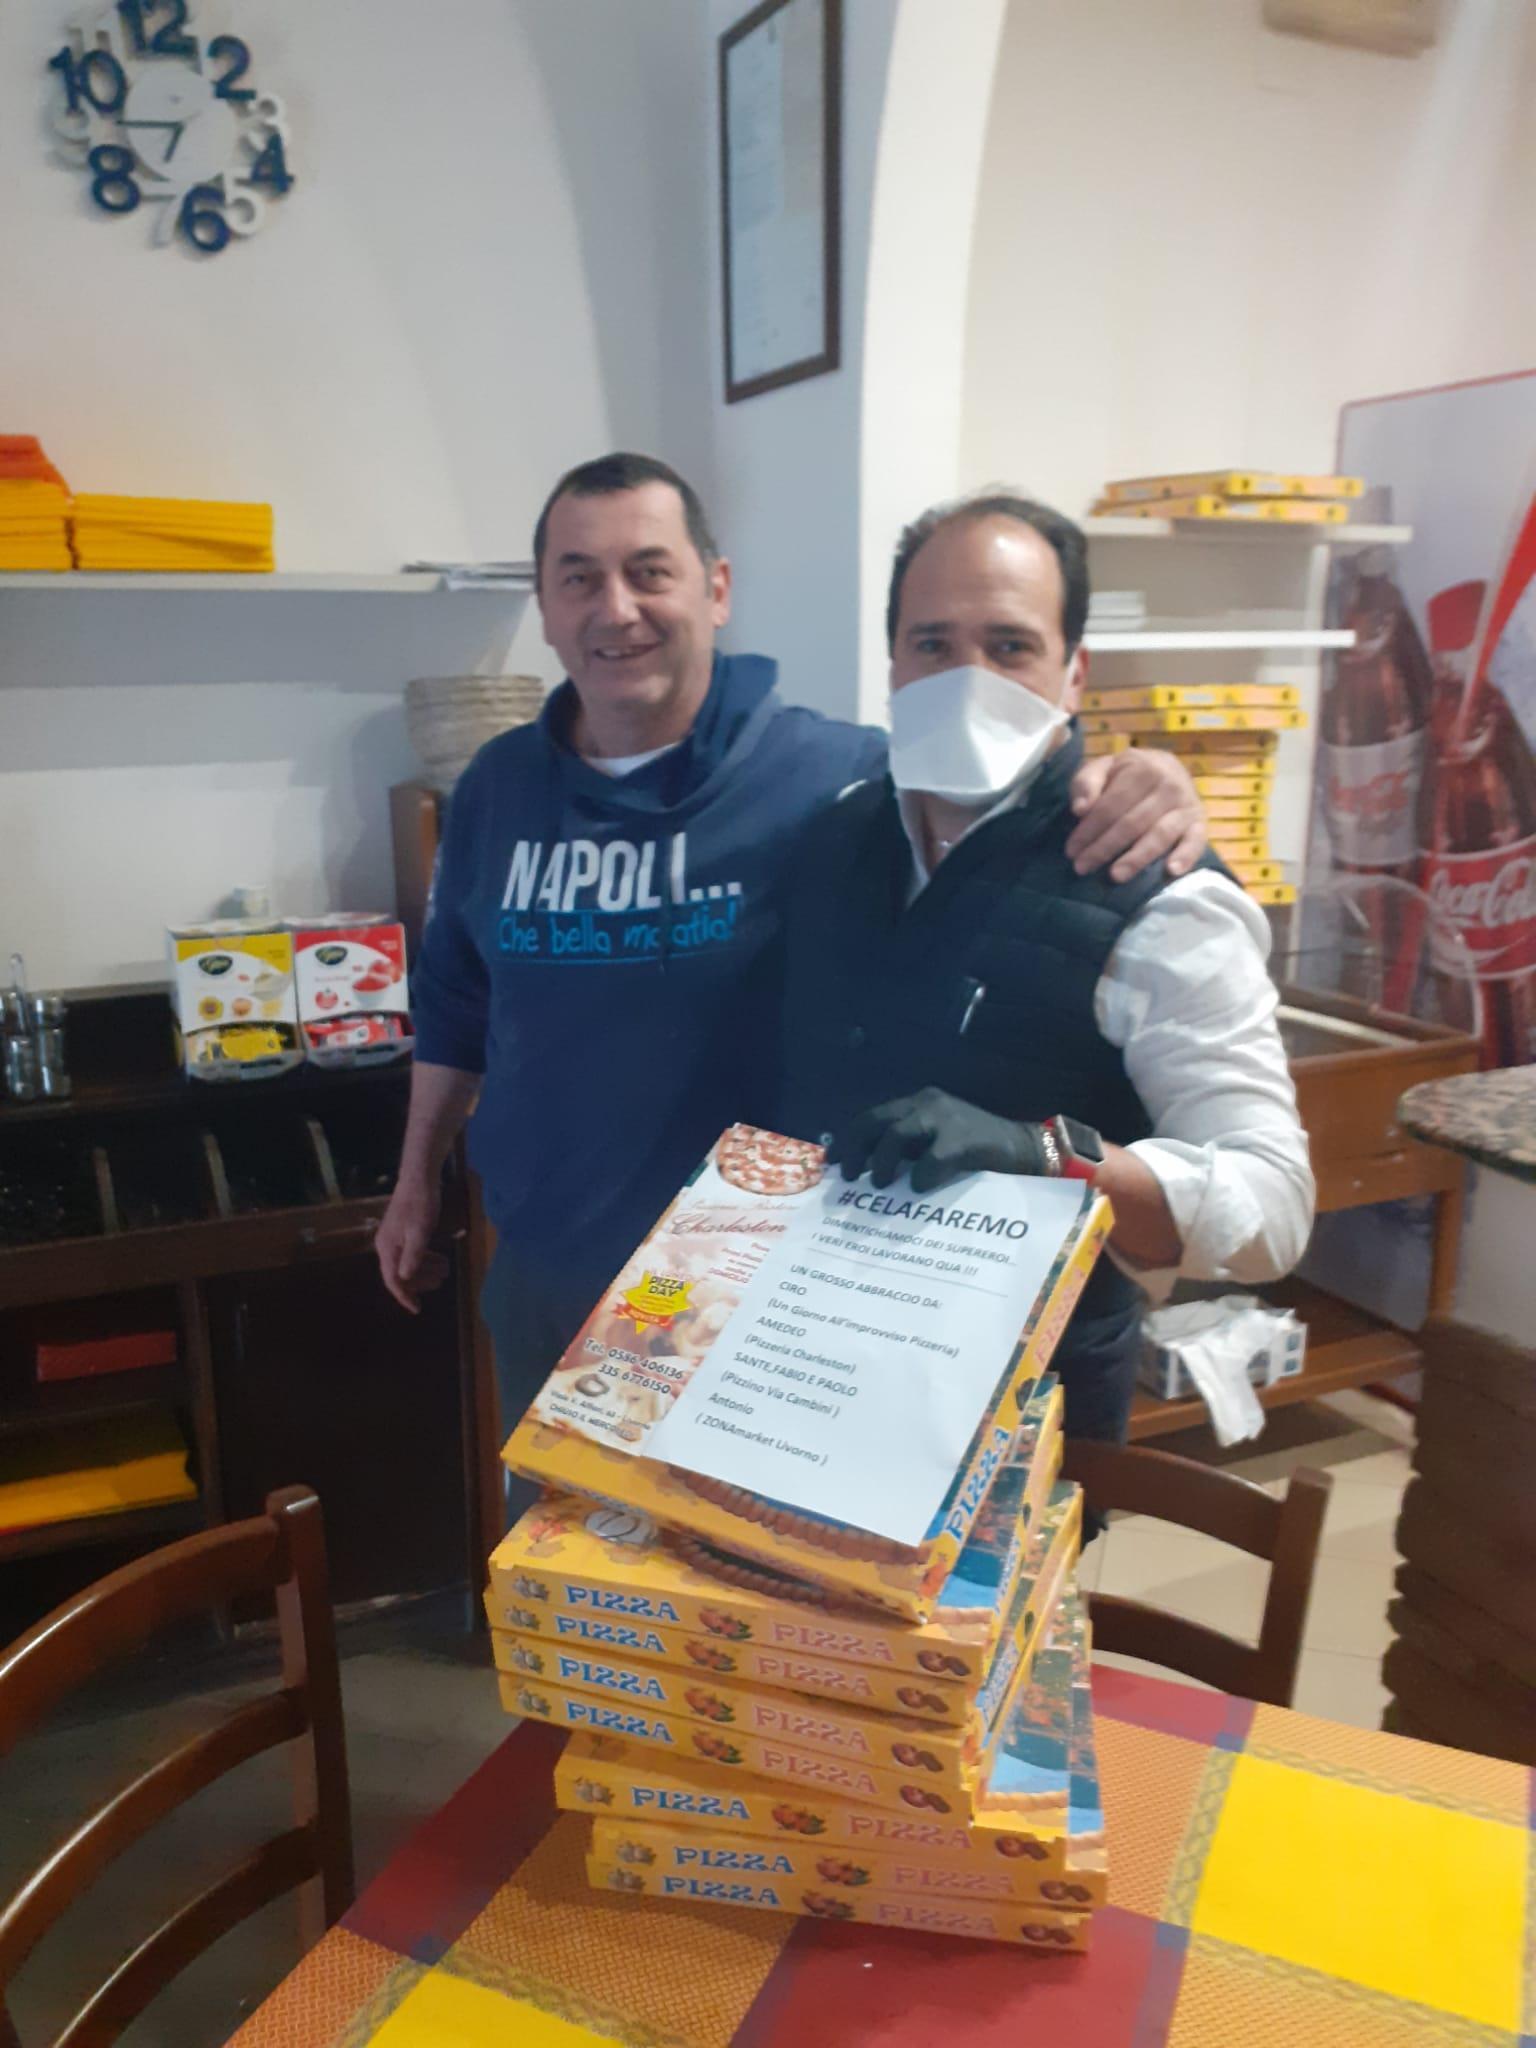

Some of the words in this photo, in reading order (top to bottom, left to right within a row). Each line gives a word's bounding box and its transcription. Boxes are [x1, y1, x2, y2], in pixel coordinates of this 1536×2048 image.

[117, 0, 198, 55] 12
[48, 46, 127, 113] 10
[207, 35, 256, 100] 2
[88, 144, 141, 212] 8
[250, 132, 294, 192] 4
[181, 184, 231, 252] 6
[501, 832, 742, 911] NAPOLI...
[500, 916, 540, 951] Che
[550, 911, 611, 955] bella
[671, 1213, 787, 1235] Charleston
[822, 1216, 923, 1245] DIMENTICHIAMOCI
[924, 1238, 944, 1250] DEI
[837, 1189, 1029, 1240] #CELAFAREMO
[818, 1233, 844, 1247] VERI
[845, 1241, 870, 1255] EROI
[871, 1247, 934, 1267] LAVORANO
[935, 1259, 961, 1273] QUA
[648, 1275, 685, 1290] PIZZA
[648, 1286, 677, 1297] DAY
[779, 1281, 807, 1296] CIRO
[790, 1264, 808, 1276] UN
[809, 1269, 855, 1289] GROSSO
[855, 1283, 921, 1305] ABBRACCIO
[922, 1298, 943, 1310] DA:
[756, 1315, 807, 1337] AMEDEO
[767, 1298, 789, 1312] (Un
[790, 1305, 827, 1322] Giorno
[908, 1335, 960, 1358] Pizzeria)
[640, 1359, 684, 1380] 406136
[744, 1333, 791, 1355] (Pizzeria
[792, 1348, 857, 1374] Charleston)
[598, 1363, 619, 1377] 335
[621, 1371, 671, 1394] 6776150
[767, 1386, 784, 1400] Via
[786, 1392, 832, 1414] Cambini
[807, 1375, 816, 1385] E
[816, 1377, 858, 1397] PAOLO
[708, 1392, 754, 1415] Antonio
[702, 1415, 774, 1446] ZONAmarket
[775, 1440, 820, 1462] Livorno
[944, 1427, 1009, 1542] PIZZA
[565, 1583, 681, 1621] PIZZA
[773, 1623, 895, 1662] PIZZA
[555, 1615, 667, 1654] PIZZA
[757, 1656, 876, 1697] PIZZA
[558, 1655, 667, 1700] PIZZA
[754, 1704, 871, 1752] PIZZA
[565, 1699, 675, 1743] PIZZA
[763, 1749, 878, 1794] PIZZA
[630, 1786, 751, 1820] PIZZA
[849, 1814, 974, 1849] PIZZA
[674, 1846, 797, 1874] PIZZA
[895, 1866, 1015, 1894] PIZZA
[663, 1875, 780, 1905] PIZZA
[878, 1903, 998, 1933] PIZZA
